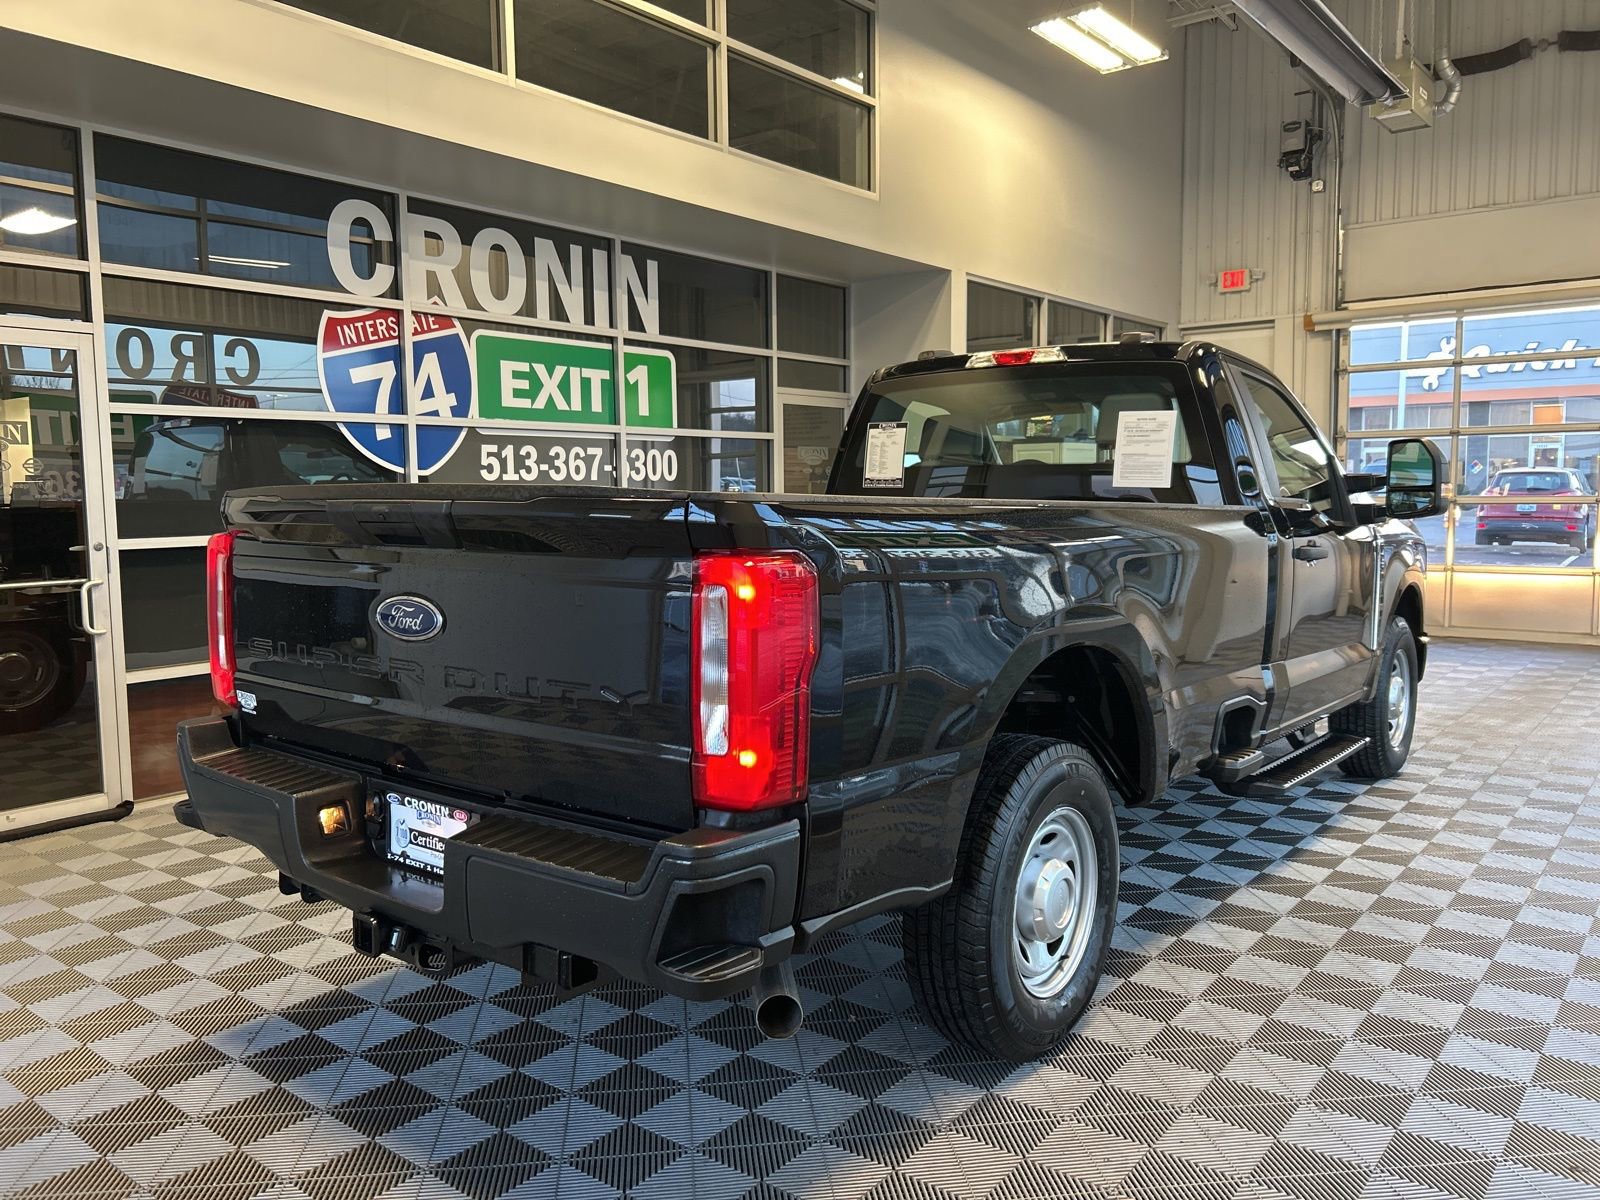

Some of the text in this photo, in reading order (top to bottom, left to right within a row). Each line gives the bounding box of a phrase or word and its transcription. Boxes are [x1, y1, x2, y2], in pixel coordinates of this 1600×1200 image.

[327, 199, 659, 335] CRONIN
[337, 313, 440, 346] INTERSATE
[1461, 338, 1590, 379] Quick
[349, 351, 458, 441] 74
[500, 360, 650, 417] EXIT 1
[389, 604, 424, 631] Ford
[248, 637, 648, 716] SUPER DUTY
[404, 796, 449, 817] CRONIN
[387, 853, 404, 863] I-74
[406, 859, 425, 869] EXIT
